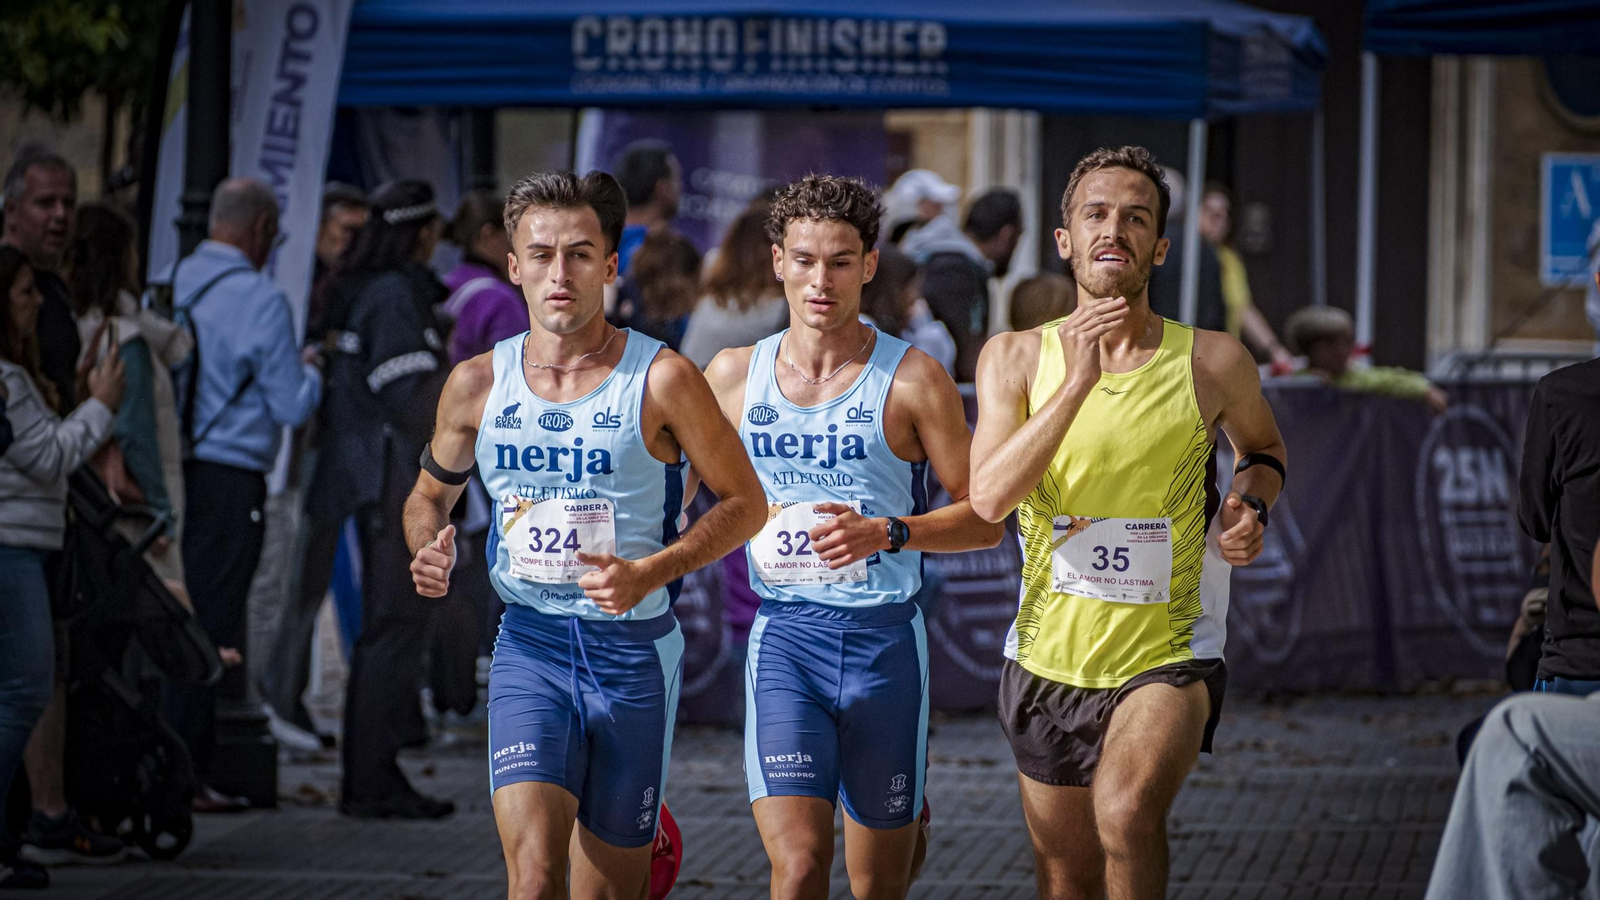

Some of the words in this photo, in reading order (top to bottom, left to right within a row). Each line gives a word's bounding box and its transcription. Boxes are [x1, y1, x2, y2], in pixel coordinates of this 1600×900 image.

[495, 415, 522, 425] CUEVA
[592, 406, 622, 428] als
[748, 407, 778, 422] TROPS
[845, 401, 874, 423] als
[539, 413, 573, 429] TROPS
[750, 423, 868, 469] nerja
[495, 437, 614, 483] nerja
[773, 470, 853, 487] ATLETISMO
[1433, 447, 1510, 503] 25N
[515, 484, 597, 500] ATLETISMO
[564, 503, 609, 512] CARRERA
[1125, 522, 1167, 530] CARRERA
[529, 526, 581, 554] 324
[777, 530, 812, 557] 32
[520, 556, 543, 567] ROMPE
[545, 559, 554, 567] EL
[556, 559, 587, 567] SILENC
[774, 561, 798, 569] AMOR
[800, 561, 812, 569] NO
[1092, 545, 1130, 572] 35
[1067, 572, 1077, 580] EL
[1079, 574, 1102, 584] AMOR
[1104, 577, 1117, 585] NO
[1118, 578, 1155, 586] LASTIMA
[493, 741, 537, 761] nerja
[498, 753, 532, 764] ATLETISMO
[764, 752, 813, 764] nerja
